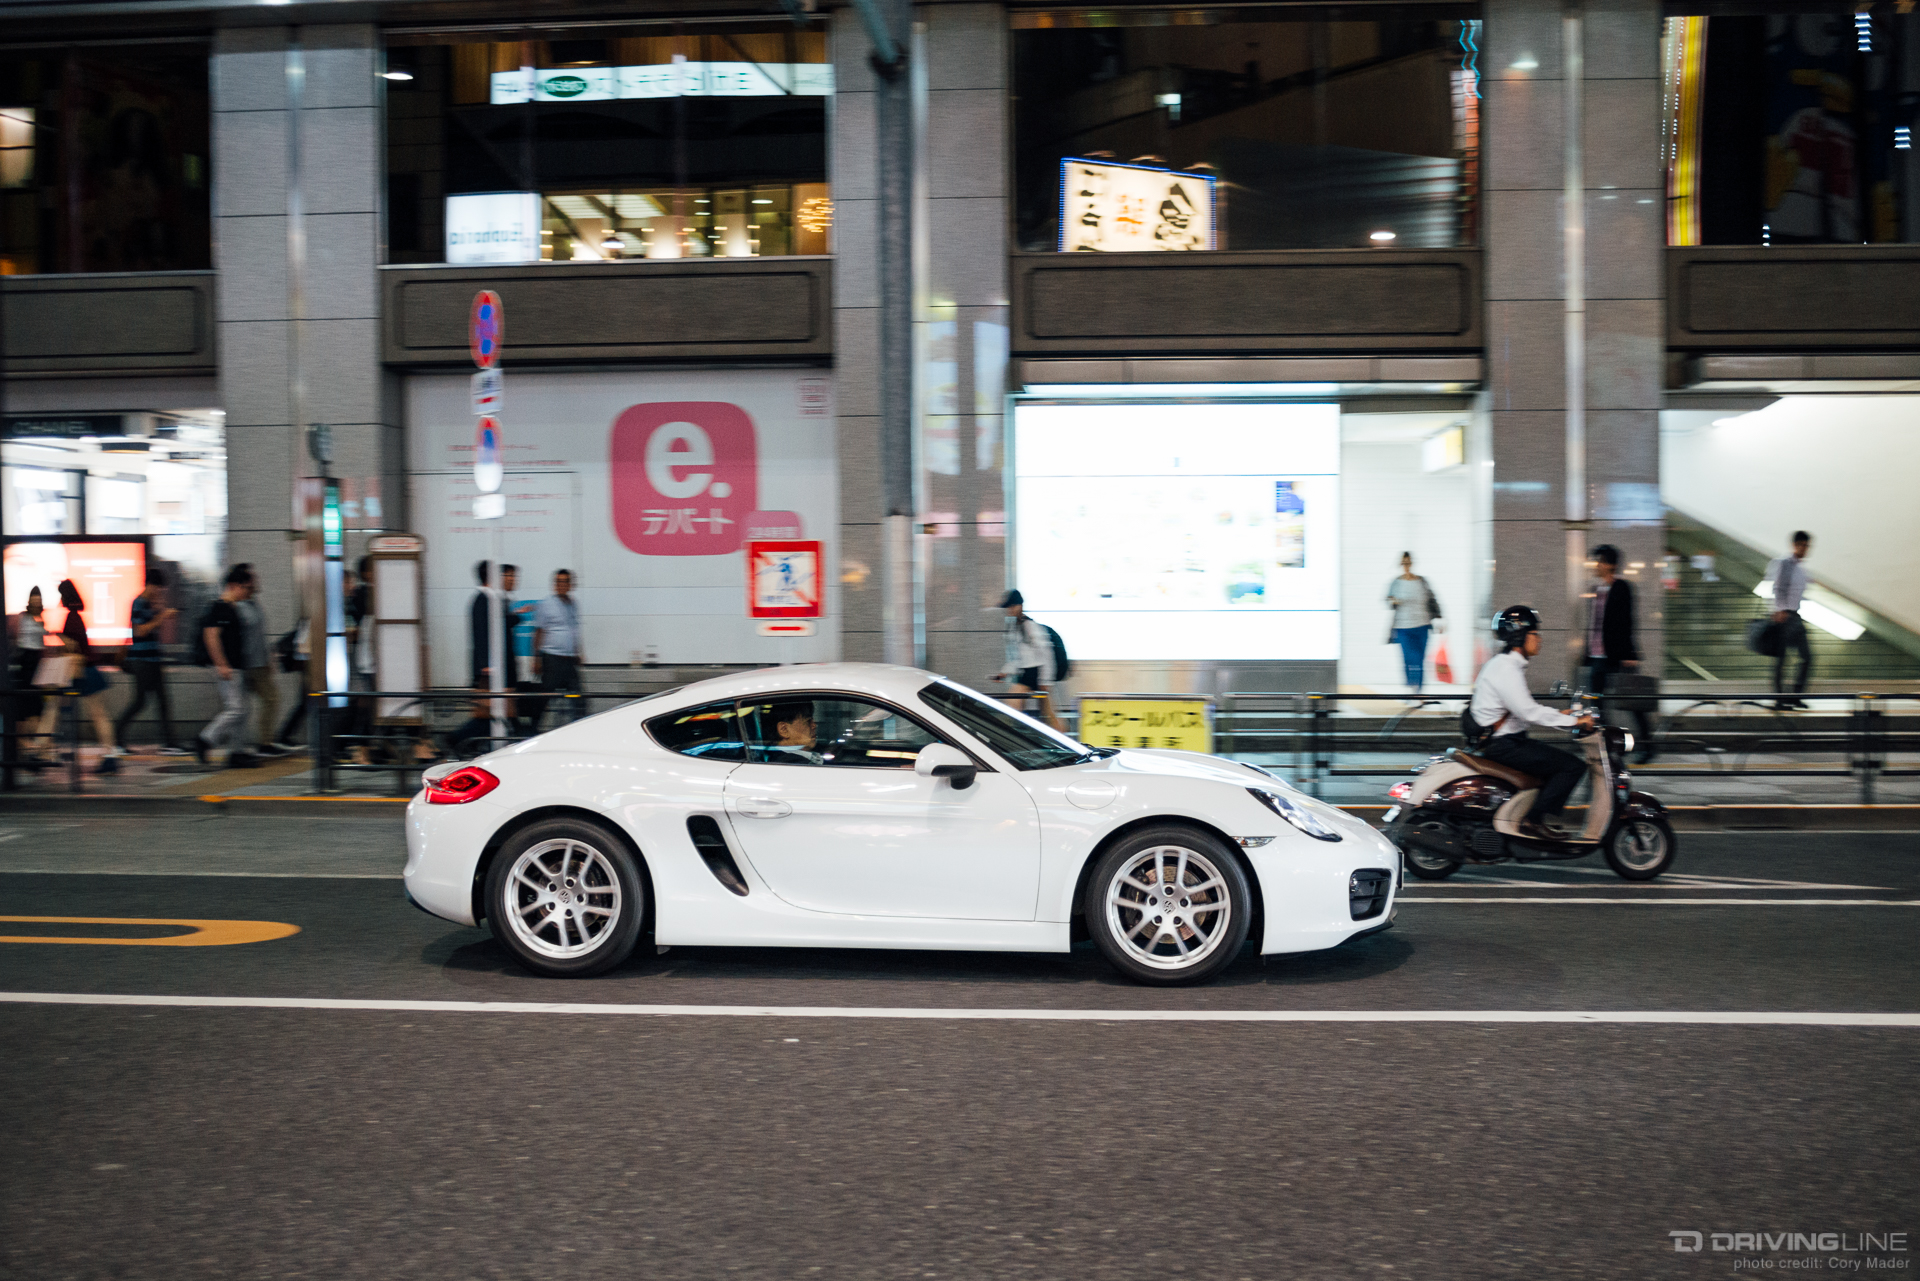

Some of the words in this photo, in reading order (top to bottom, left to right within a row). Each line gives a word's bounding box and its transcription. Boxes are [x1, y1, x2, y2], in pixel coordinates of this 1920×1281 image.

[644, 421, 734, 499] e.
[1085, 709, 1204, 728] スクールバス
